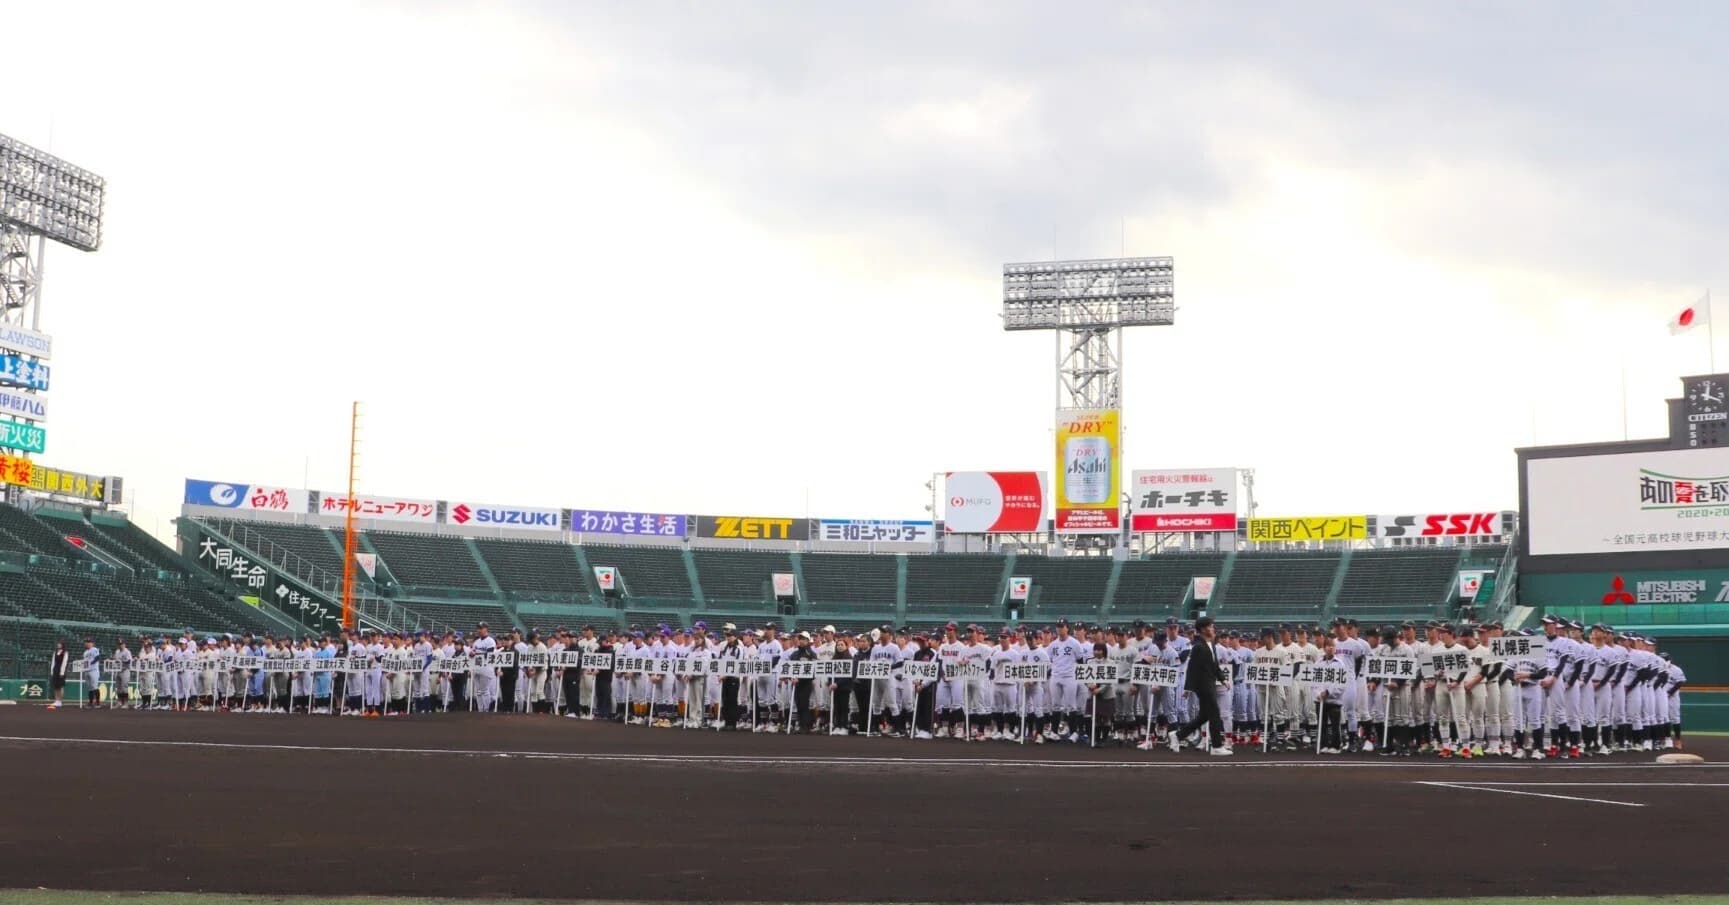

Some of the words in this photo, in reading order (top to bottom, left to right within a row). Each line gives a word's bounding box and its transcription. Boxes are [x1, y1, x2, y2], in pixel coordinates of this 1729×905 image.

[1688, 412, 1728, 421] CITIZEN
[1067, 456, 1106, 474] Asahi
[1140, 490, 1228, 508] ホーチキ
[476, 508, 557, 526] SUZUKI
[581, 512, 677, 534] わかさ生活
[1421, 513, 1497, 536] SSK
[714, 517, 792, 540] ZETT
[827, 524, 926, 541] 三和シャッター
[1251, 518, 1364, 539] 関西ペイント
[199, 537, 267, 588] 大同生命
[1636, 579, 1706, 592] MITSUBISHI
[1637, 592, 1697, 603] ELECTRIC
[1492, 639, 1544, 656] 札幌第一
[488, 654, 512, 665] 津久見
[583, 655, 610, 667] 宮崎日大
[616, 659, 642, 670] 秀岳館
[678, 660, 702, 672] 高知
[710, 661, 735, 674] 鳴門
[1368, 659, 1414, 676] 鶴岡東
[1422, 653, 1469, 670] 一関学院
[781, 663, 812, 675] 倉吉東
[816, 662, 851, 675] 三田松聖
[1004, 665, 1045, 679] 日本航空石川
[1075, 665, 1117, 681] 佐久長聖
[1133, 666, 1177, 683] 東海大甲府
[1247, 666, 1291, 683] 桐生第一
[1301, 667, 1347, 684] 土浦湖北
